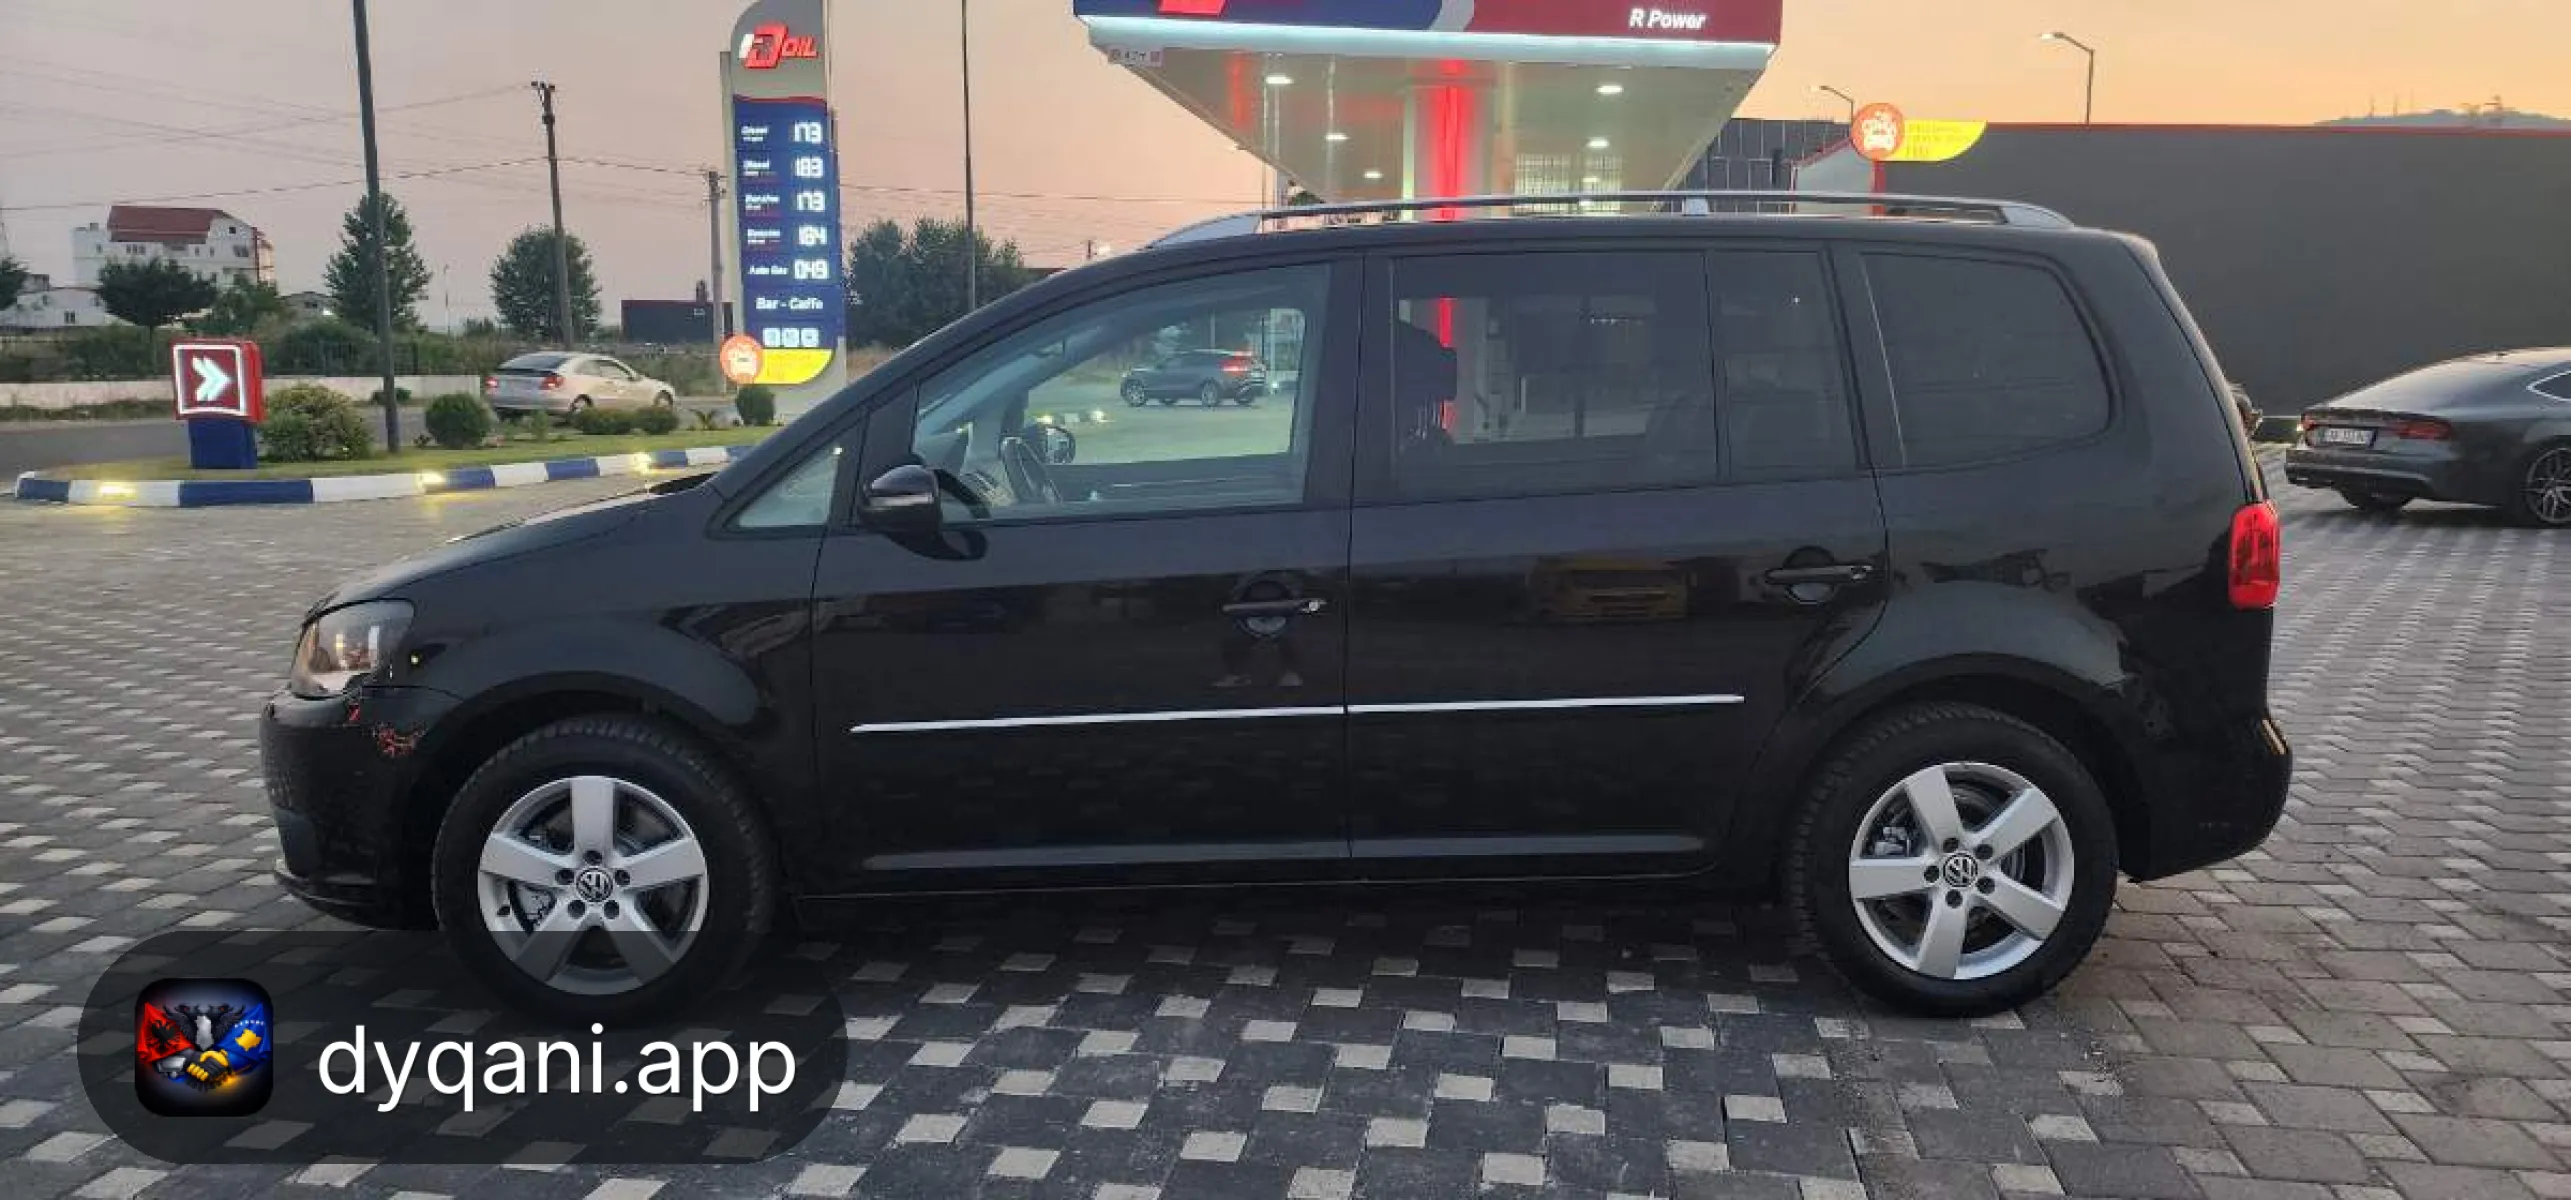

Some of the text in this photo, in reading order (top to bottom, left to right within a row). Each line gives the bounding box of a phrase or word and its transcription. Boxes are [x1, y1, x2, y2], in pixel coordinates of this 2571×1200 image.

[1629, 8, 1707, 29] R Power
[793, 121, 823, 144] 173
[795, 156, 824, 177] 183
[796, 190, 826, 212] 173
[755, 297, 778, 310] Bar
